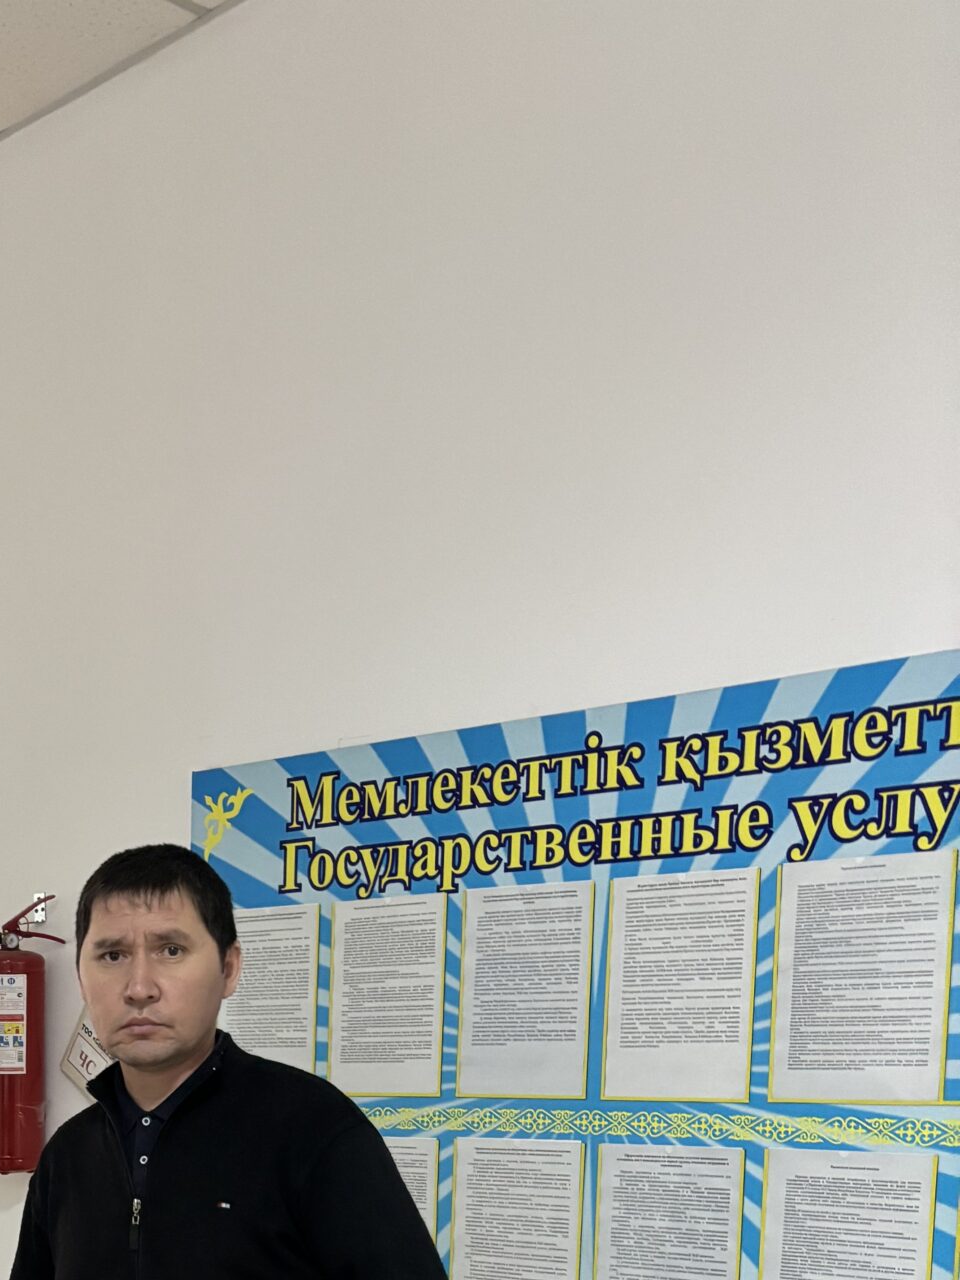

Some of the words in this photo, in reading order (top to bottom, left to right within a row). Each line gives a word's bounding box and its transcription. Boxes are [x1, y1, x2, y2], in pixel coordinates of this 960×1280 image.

[286, 731, 645, 832] Мемлекеттік
[279, 800, 773, 900] Государственные
[786, 780, 960, 863] услу
[81, 1023, 93, 1038] ТОО
